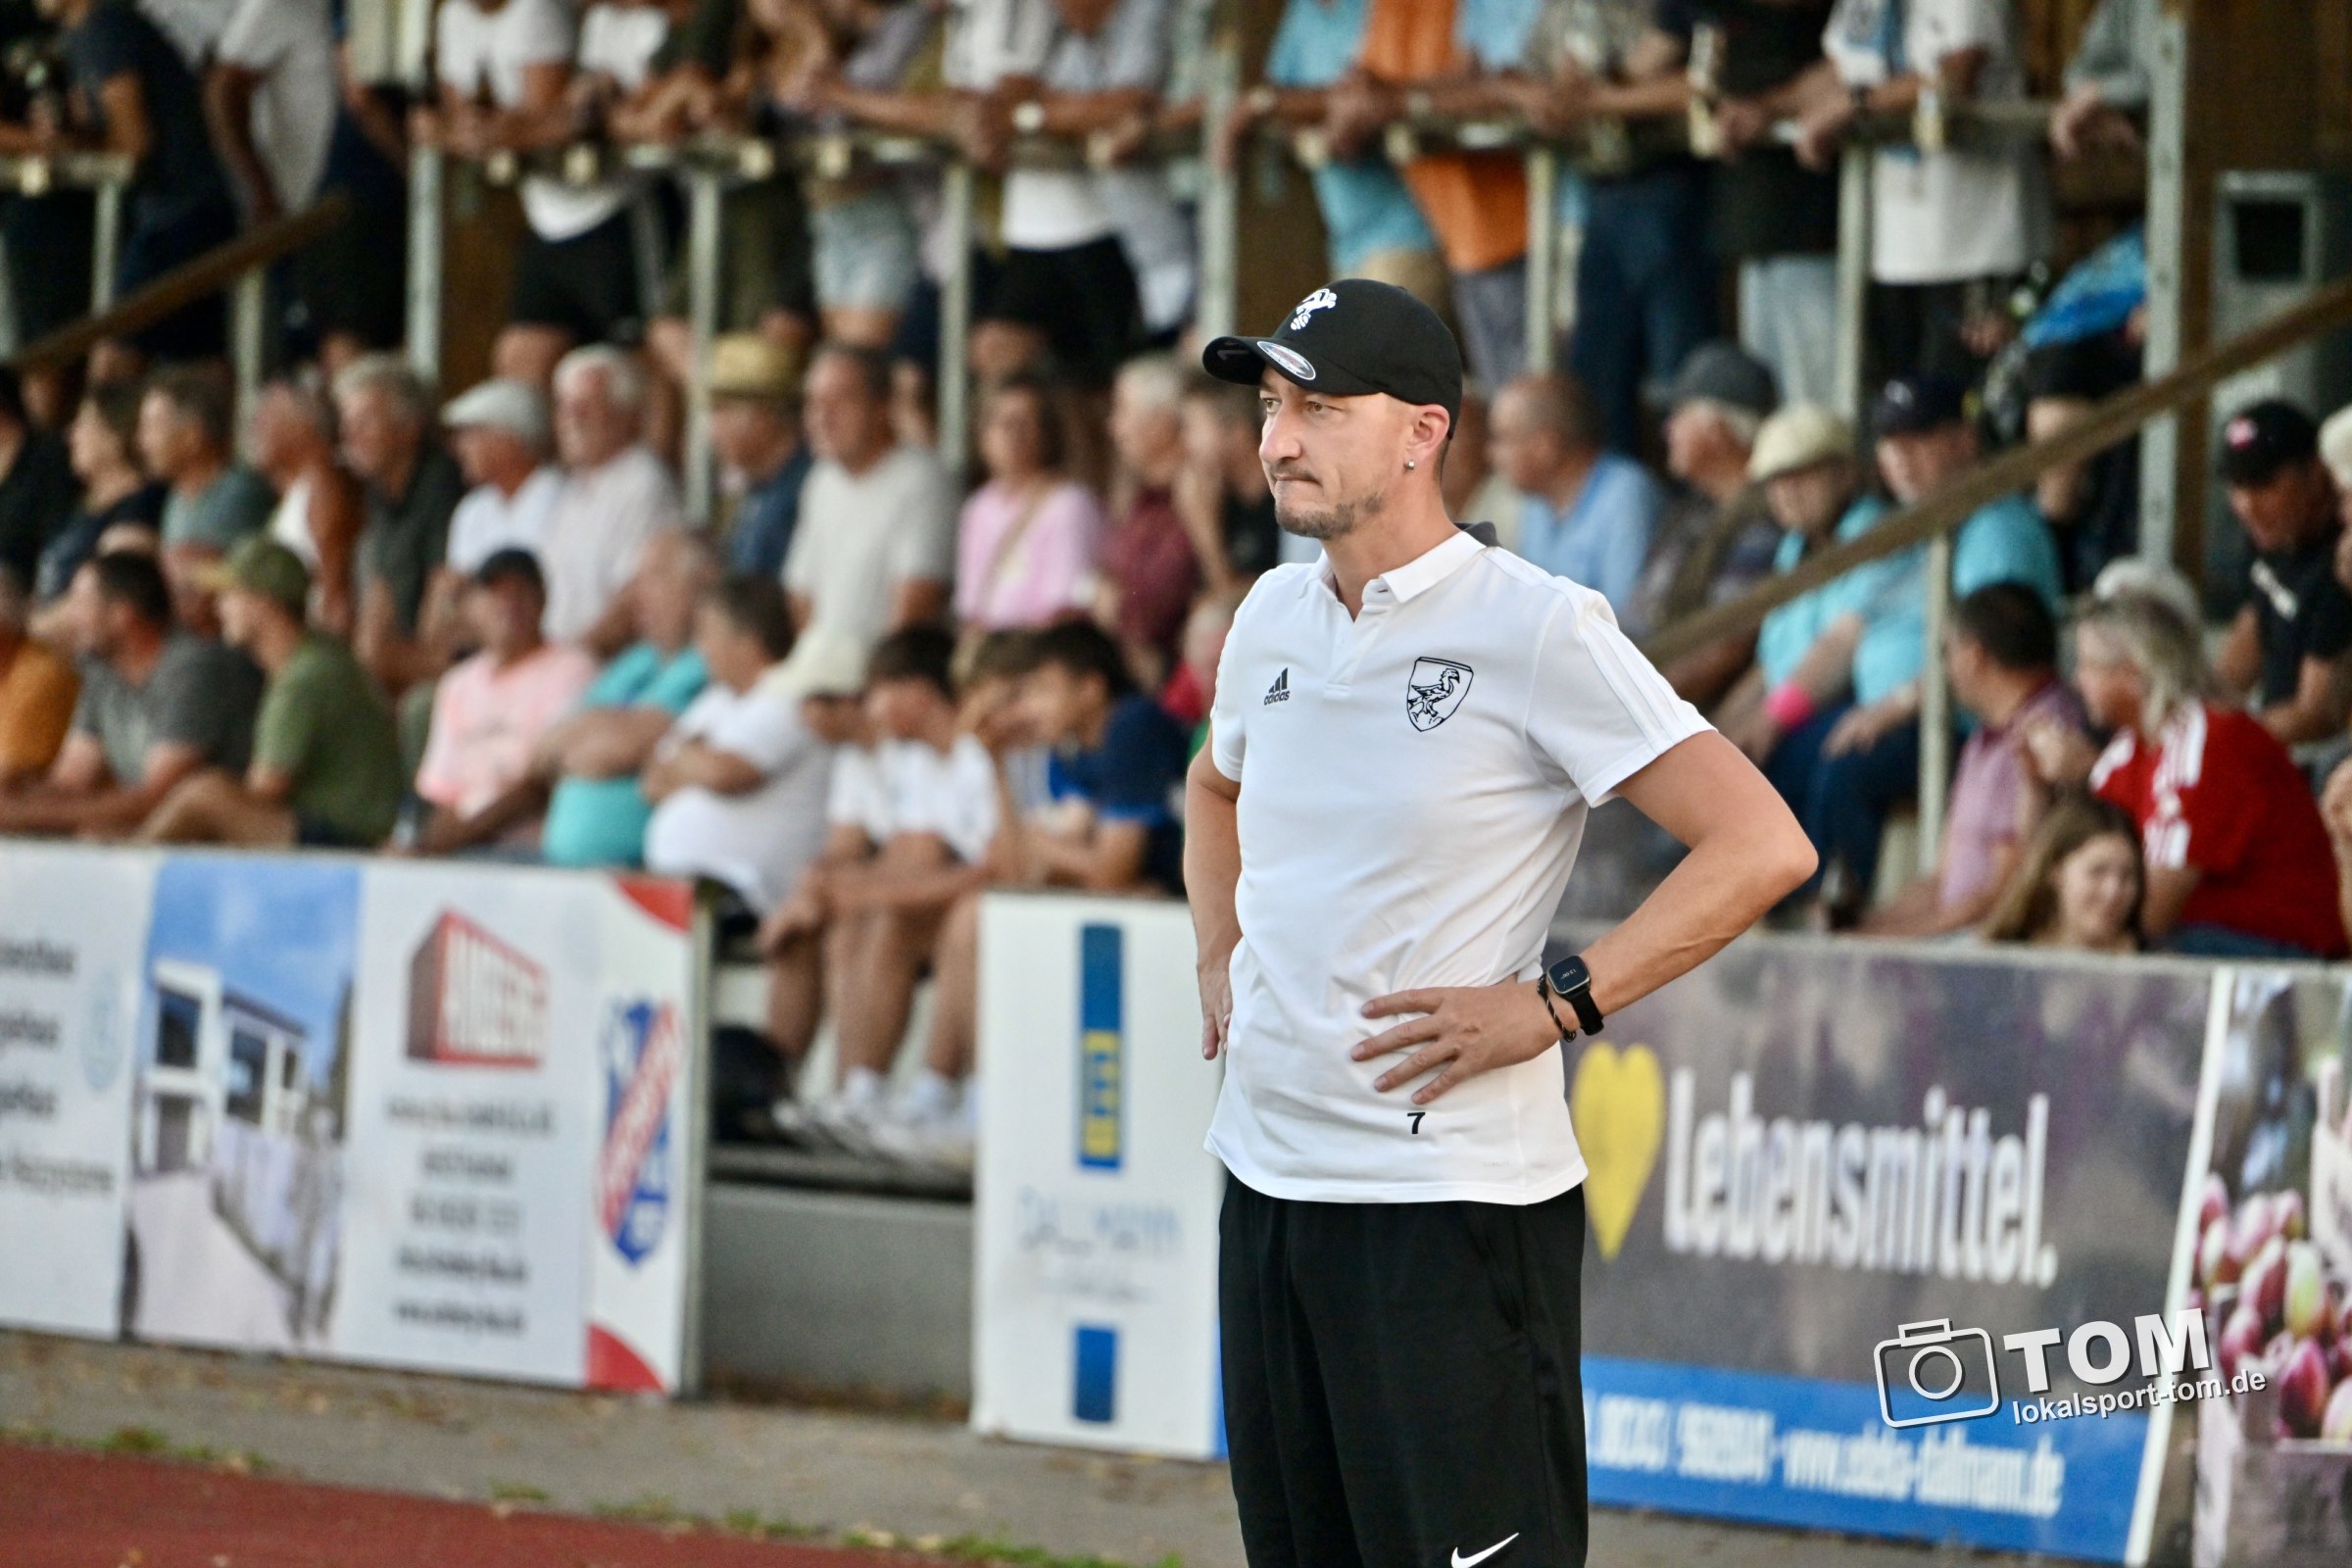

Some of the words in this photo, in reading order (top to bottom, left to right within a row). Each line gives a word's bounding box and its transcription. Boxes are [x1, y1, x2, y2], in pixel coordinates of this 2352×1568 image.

[1263, 690, 1291, 707] adidas
[1406, 1111, 1426, 1135] 7
[1665, 1068, 2058, 1288] Lebensmittel.
